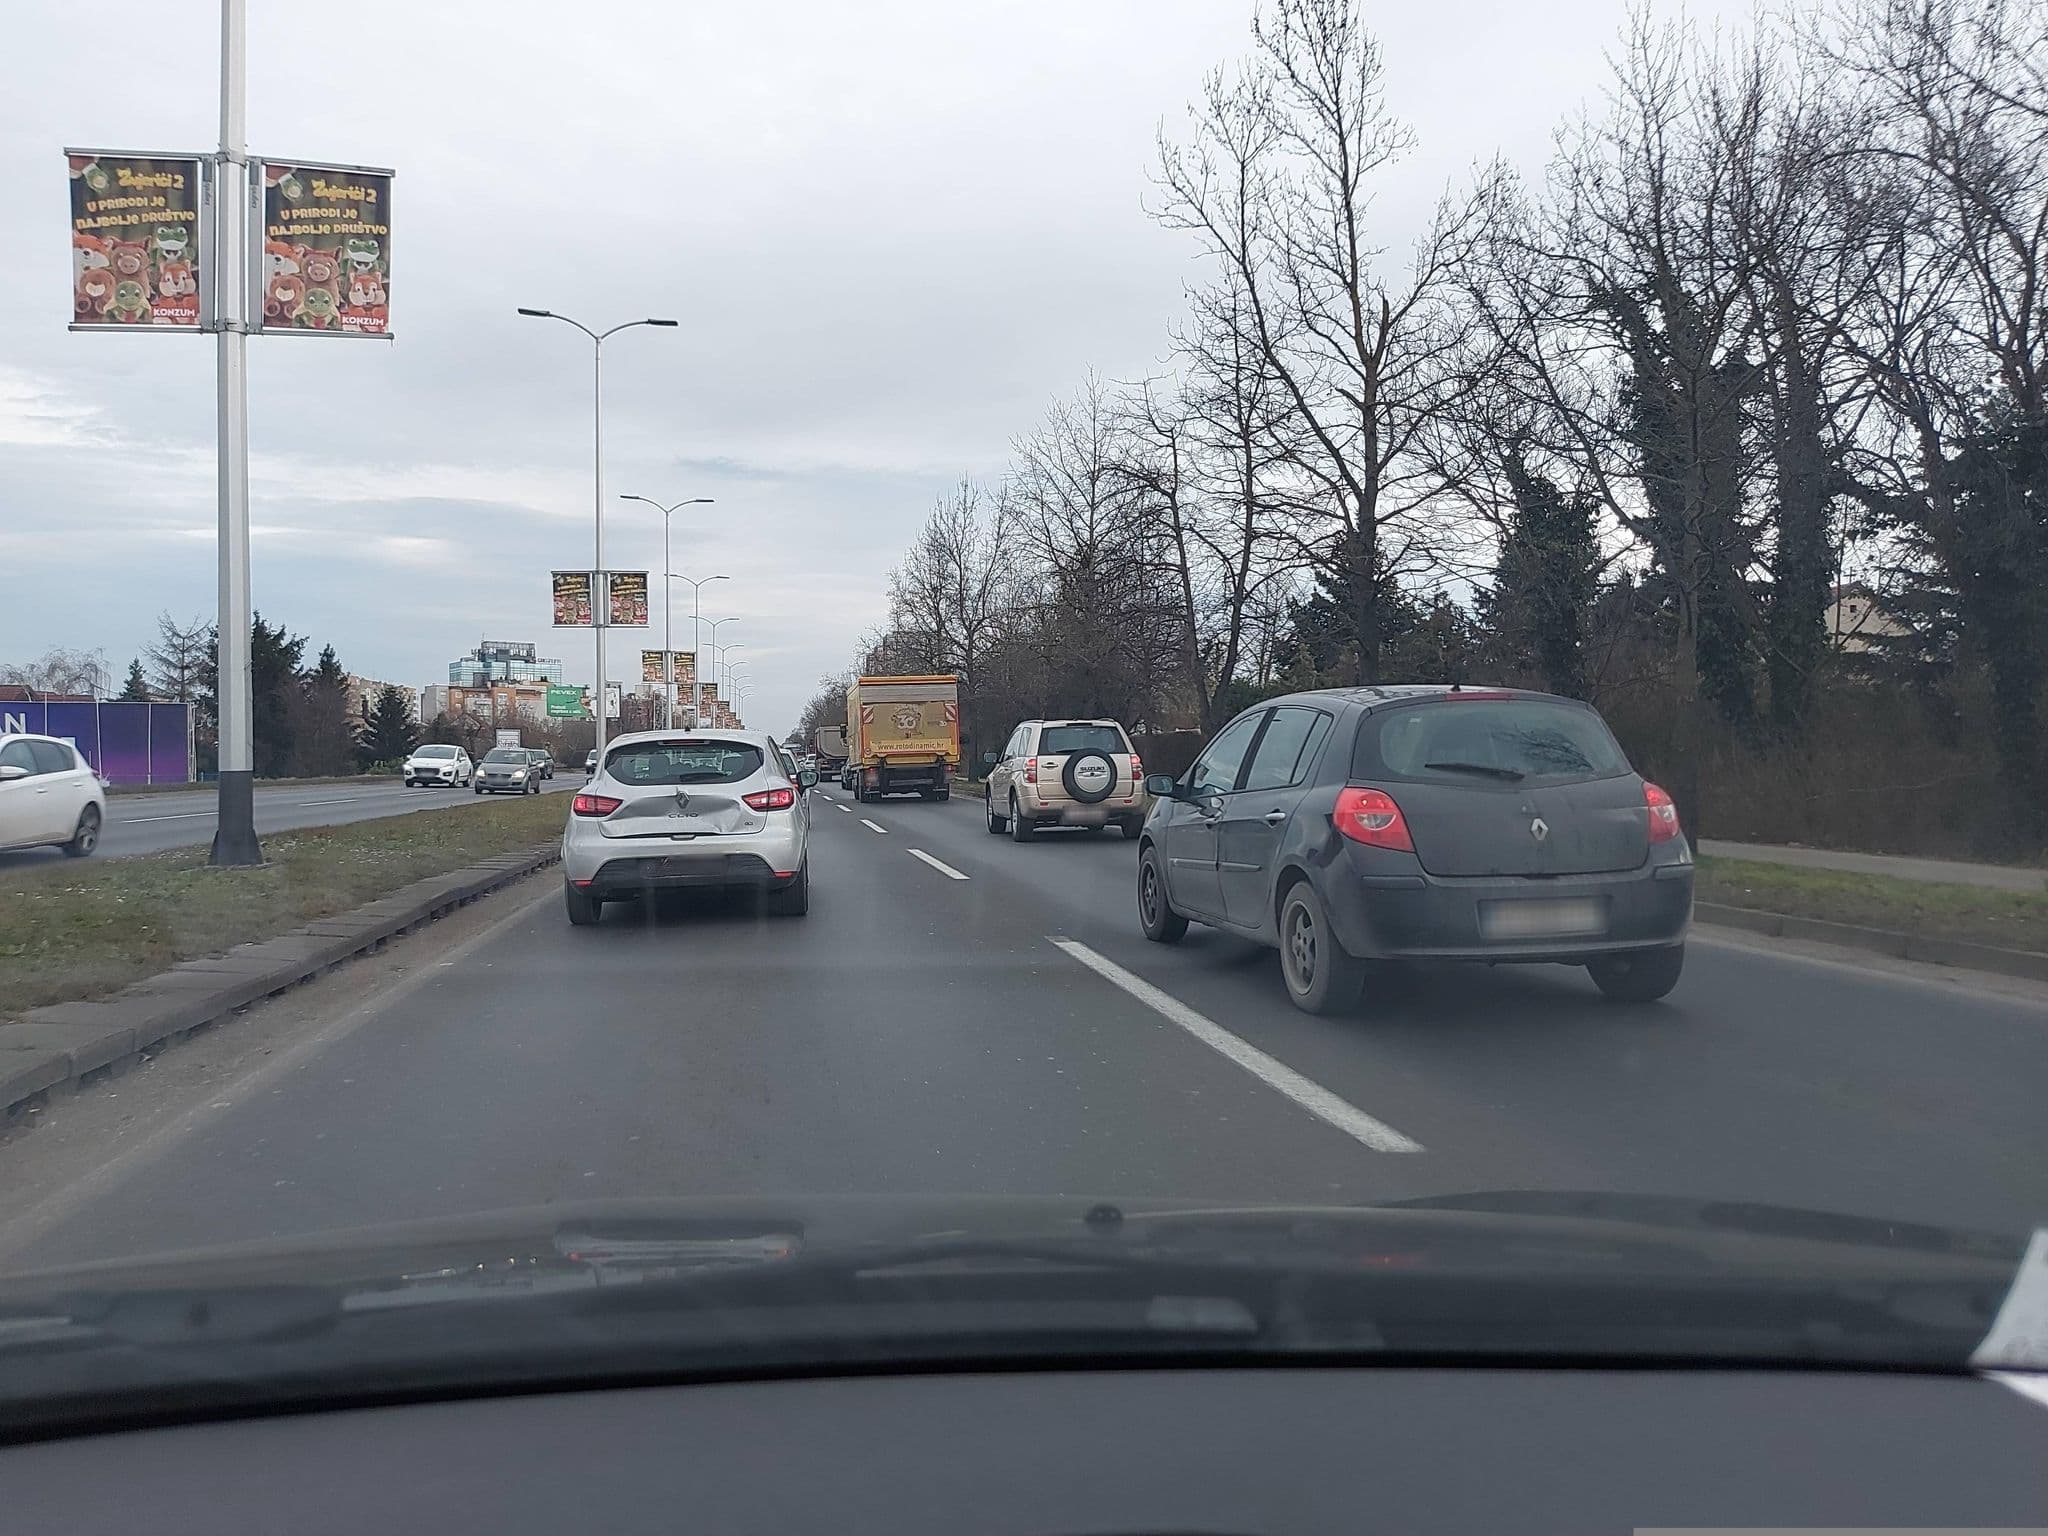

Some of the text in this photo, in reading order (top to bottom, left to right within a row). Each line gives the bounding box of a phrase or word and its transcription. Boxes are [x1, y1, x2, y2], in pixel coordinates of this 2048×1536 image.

[173, 174, 185, 190] 2
[366, 188, 377, 204] 2
[86, 201, 97, 212] U
[98, 197, 148, 211] PRIRODI
[141, 209, 196, 223] DRUŠTVO
[280, 209, 290, 220] U
[292, 207, 341, 219] PRIRODI
[333, 221, 388, 235] DRUŠTVO
[153, 308, 195, 317] KONZUM
[342, 316, 384, 326] KONZUM
